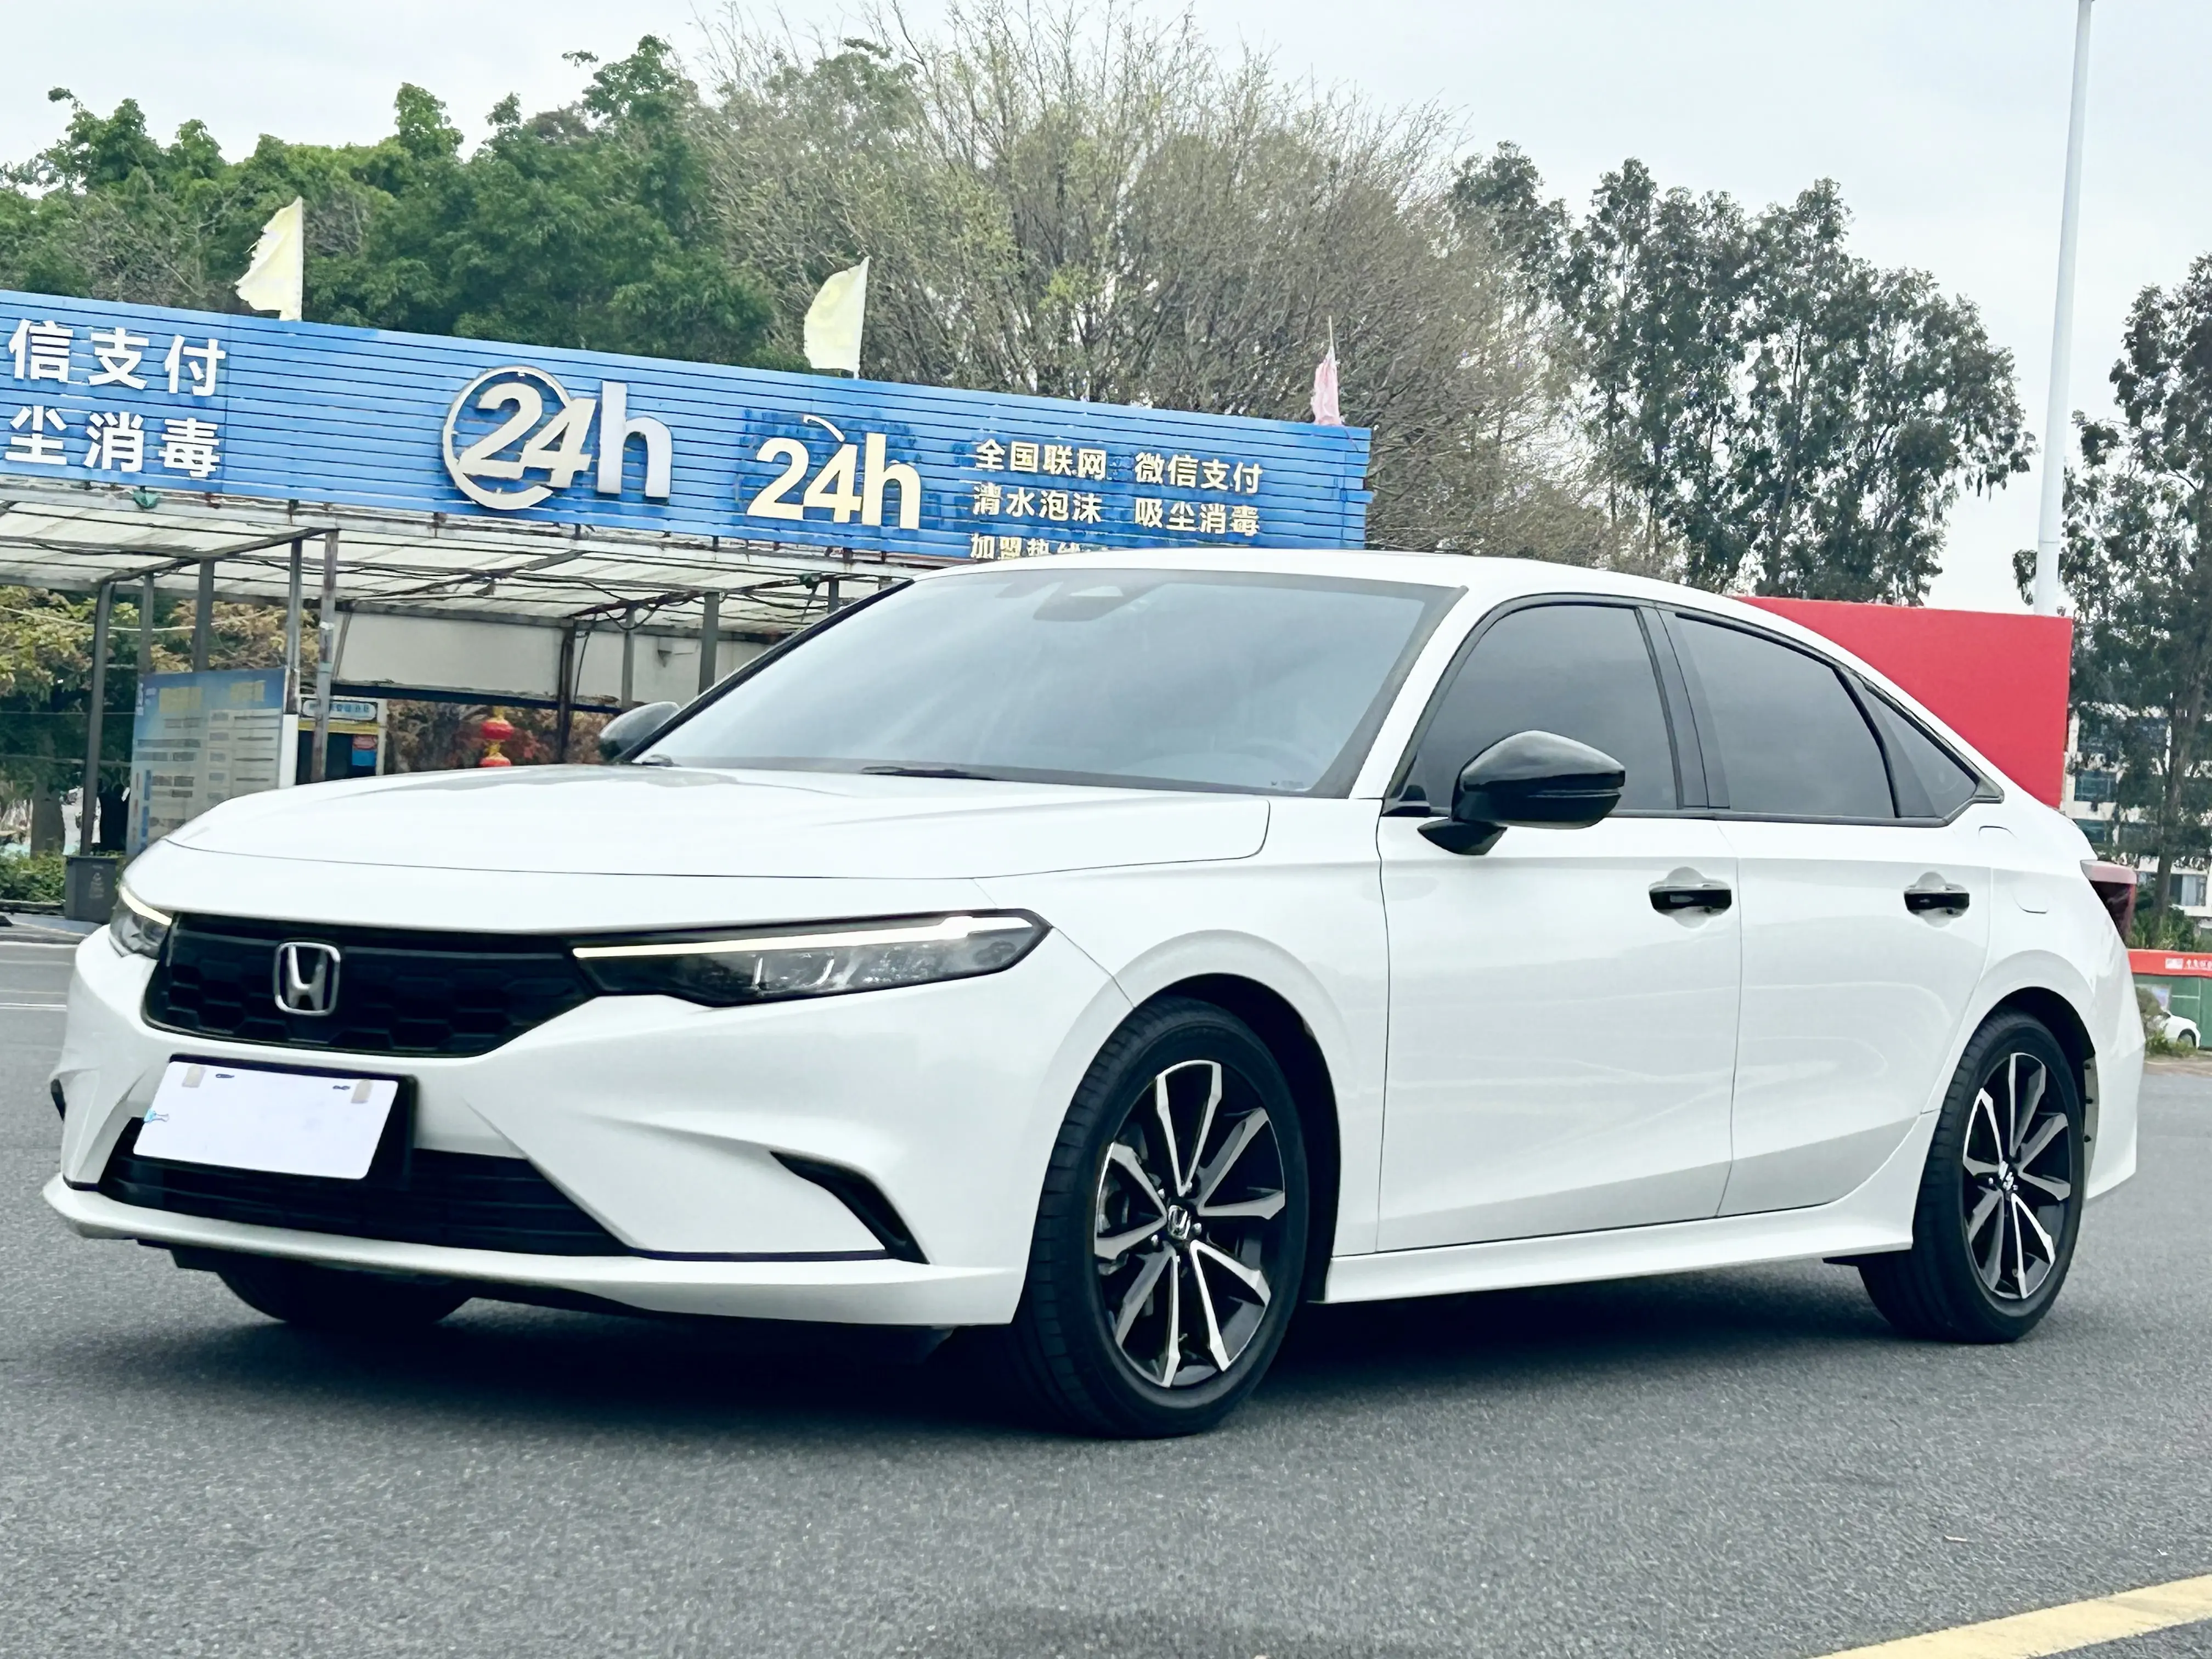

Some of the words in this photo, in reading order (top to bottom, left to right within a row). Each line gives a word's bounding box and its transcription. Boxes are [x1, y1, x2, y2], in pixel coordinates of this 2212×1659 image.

[8, 319, 226, 397] 信支付
[4, 405, 221, 479] 尘消毒
[458, 380, 673, 498] 24h
[975, 438, 1107, 481] 全国联网
[1134, 452, 1263, 494] 微信支付
[746, 432, 922, 530] 24h
[972, 481, 1103, 524] 清水泡沫
[1134, 497, 1260, 537] 吸尘消毒
